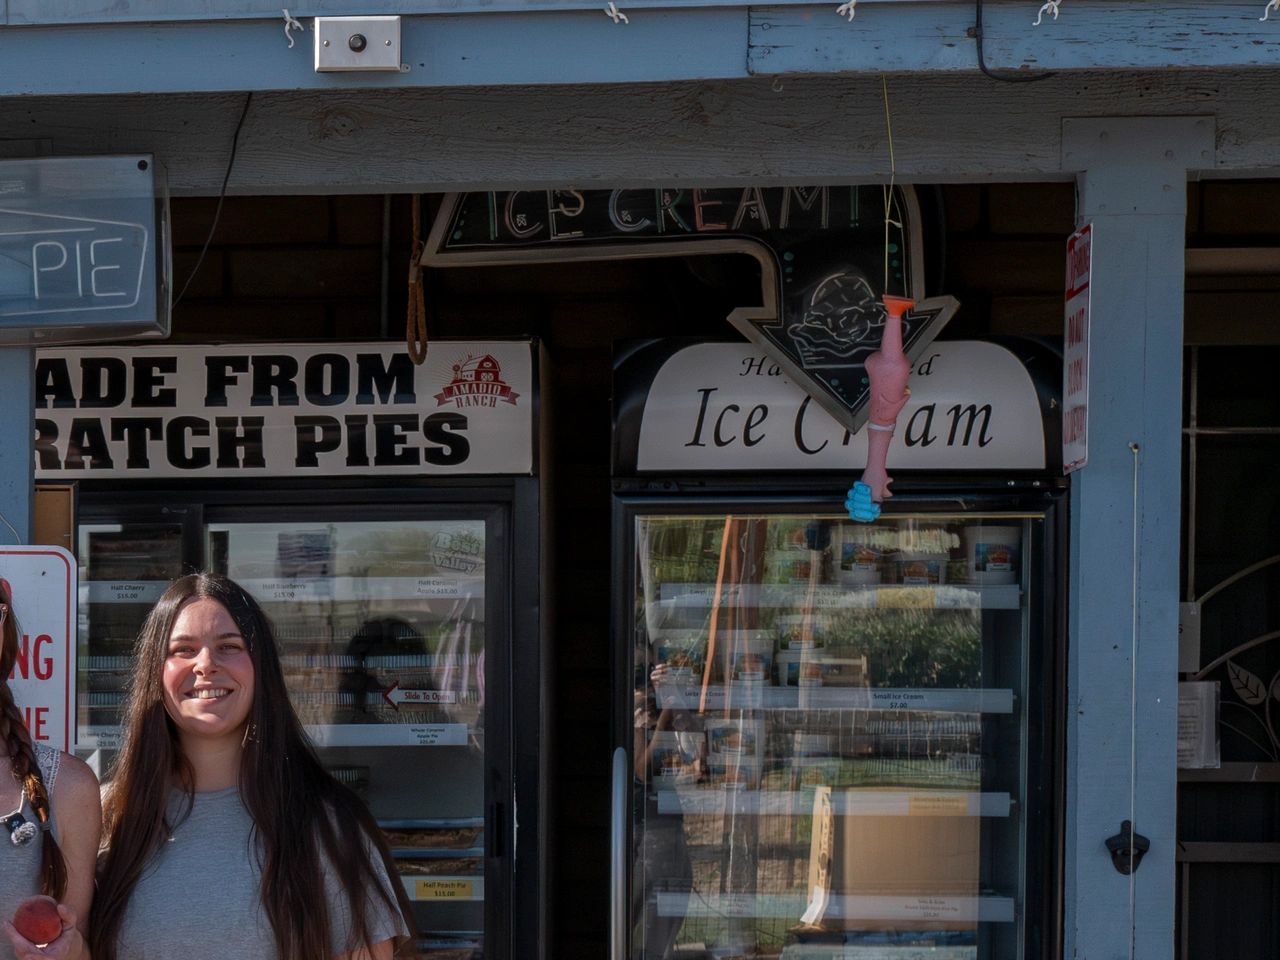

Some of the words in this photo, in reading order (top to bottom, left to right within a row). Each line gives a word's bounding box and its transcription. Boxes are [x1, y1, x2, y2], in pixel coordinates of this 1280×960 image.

[32, 237, 127, 300] PIE
[36, 356, 178, 409] ADE
[204, 352, 418, 408] FROM
[452, 383, 501, 396] AMADIO
[455, 395, 498, 409] RANCH
[294, 412, 471, 468] PIES
[684, 387, 770, 448] Ice
[794, 395, 994, 455] Cam
[404, 691, 420, 700] Slide
[423, 692, 430, 700] To
